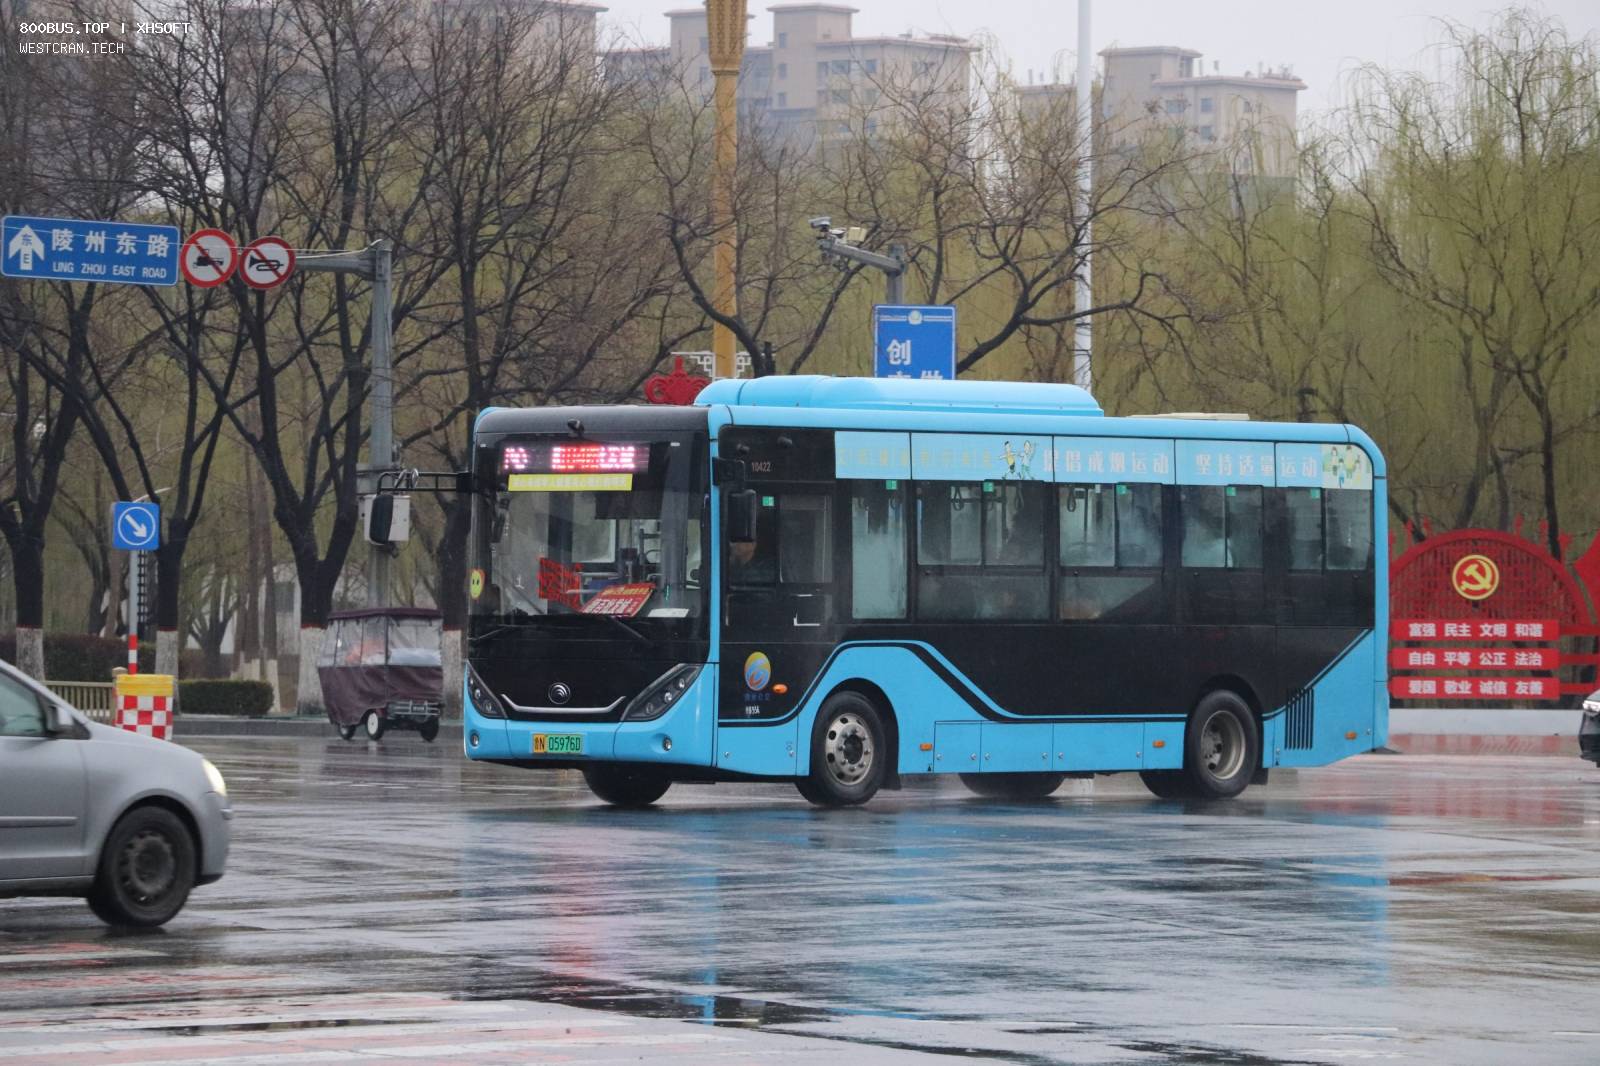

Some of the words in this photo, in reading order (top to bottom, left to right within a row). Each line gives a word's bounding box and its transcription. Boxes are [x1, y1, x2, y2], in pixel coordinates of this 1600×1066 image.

[51, 227, 170, 258] 陵州东路
[23, 253, 30, 265] E
[52, 262, 75, 273] LING
[81, 263, 106, 275] ZHOU
[112, 265, 136, 277] EAST
[142, 267, 167, 279] ROAD
[886, 339, 912, 366] 创
[1408, 623, 1437, 638] 富强
[1444, 623, 1472, 638] 民主
[1479, 623, 1508, 638] 文明
[1514, 623, 1543, 638] 和谐
[1408, 651, 1436, 667] 自由
[1443, 651, 1471, 667] 平等
[1479, 652, 1507, 667] 公正
[1514, 652, 1543, 667] 法治
[1408, 679, 1437, 695] 爱国
[1444, 680, 1472, 695] 敬业
[1479, 680, 1508, 696] 诚信
[1514, 680, 1543, 696] 友善
